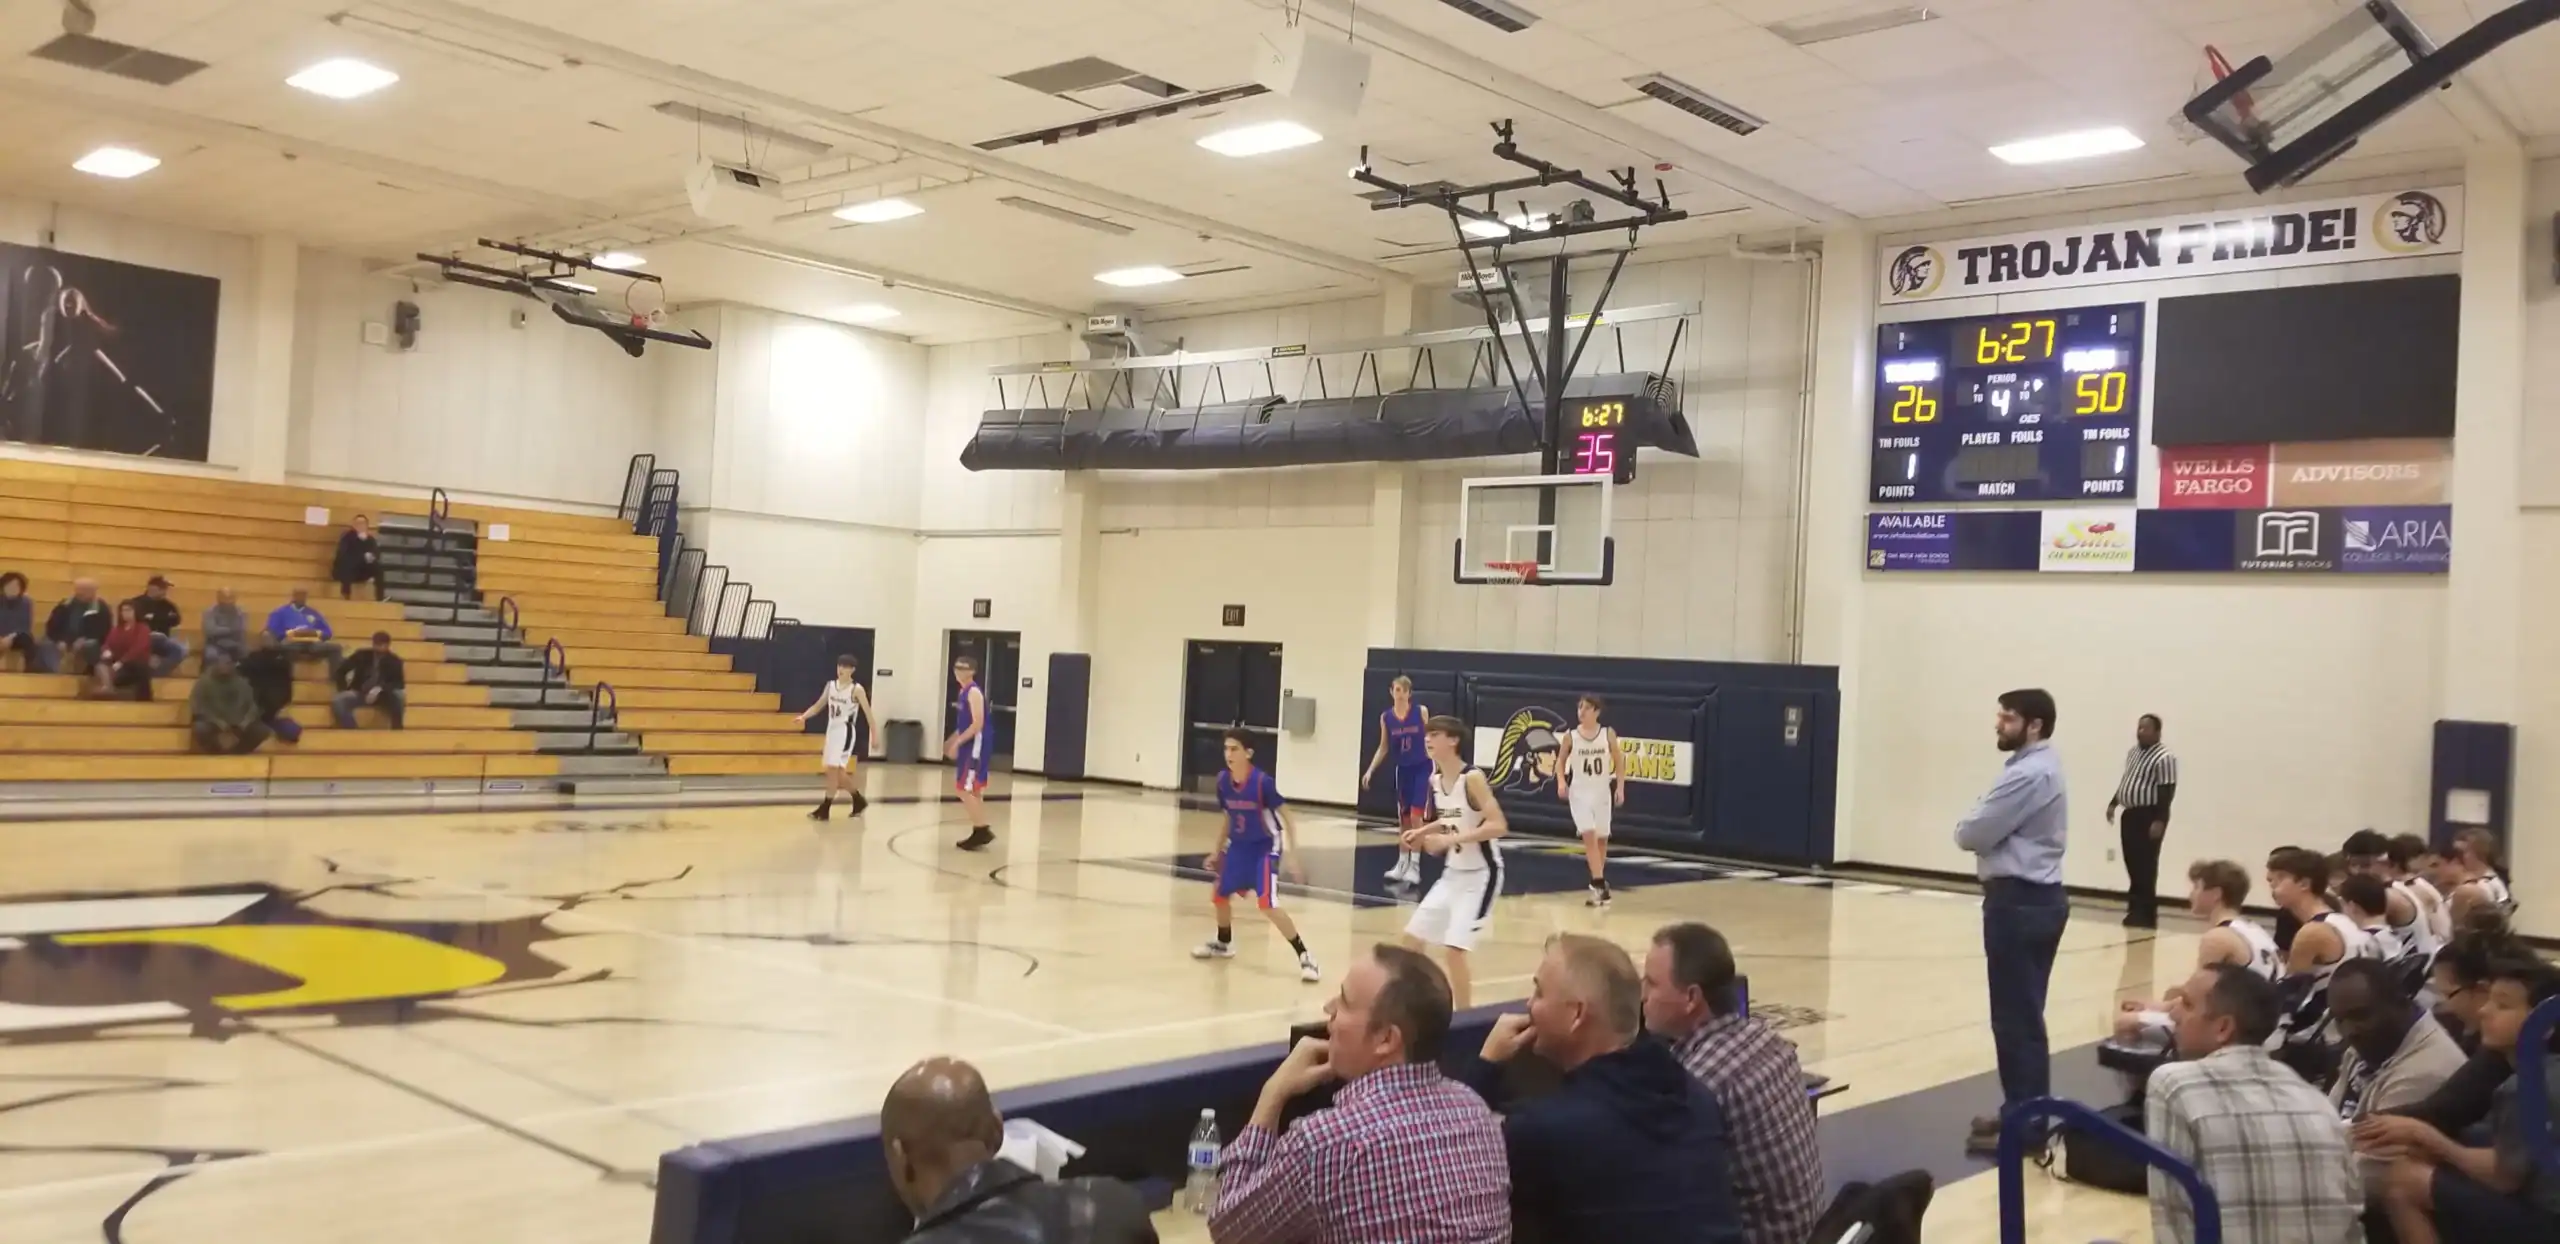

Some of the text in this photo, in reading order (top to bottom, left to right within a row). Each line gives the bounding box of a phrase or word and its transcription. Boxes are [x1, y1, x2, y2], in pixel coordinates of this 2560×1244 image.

[1958, 227, 2163, 285] TROJAN
[1977, 320, 2056, 364] 6:27
[1987, 373, 2017, 384] PERIOD
[1991, 389, 2010, 417] 4
[2075, 372, 2127, 415] 50
[1892, 385, 1937, 423] 26
[1582, 403, 1624, 427] 6:27
[1879, 437, 1921, 448] TM FOULS
[1962, 430, 2043, 446] PLAYER FOULS
[2083, 427, 2130, 440] TM FOULS
[1575, 434, 1614, 472] 35
[2114, 445, 2125, 474] 1
[1907, 453, 1917, 480] 1
[2172, 458, 2256, 476] WELLS
[2291, 464, 2420, 483] ADVISORS
[1879, 485, 1915, 498] POINTS
[1978, 482, 2016, 495] MATCH
[2083, 480, 2124, 493] POINTS
[2173, 478, 2253, 496] FARGO
[1878, 514, 1946, 529] AVAILABLE
[2378, 520, 2452, 549] ARIA
[1644, 743, 1676, 757] THE
[1583, 757, 1603, 776] 40
